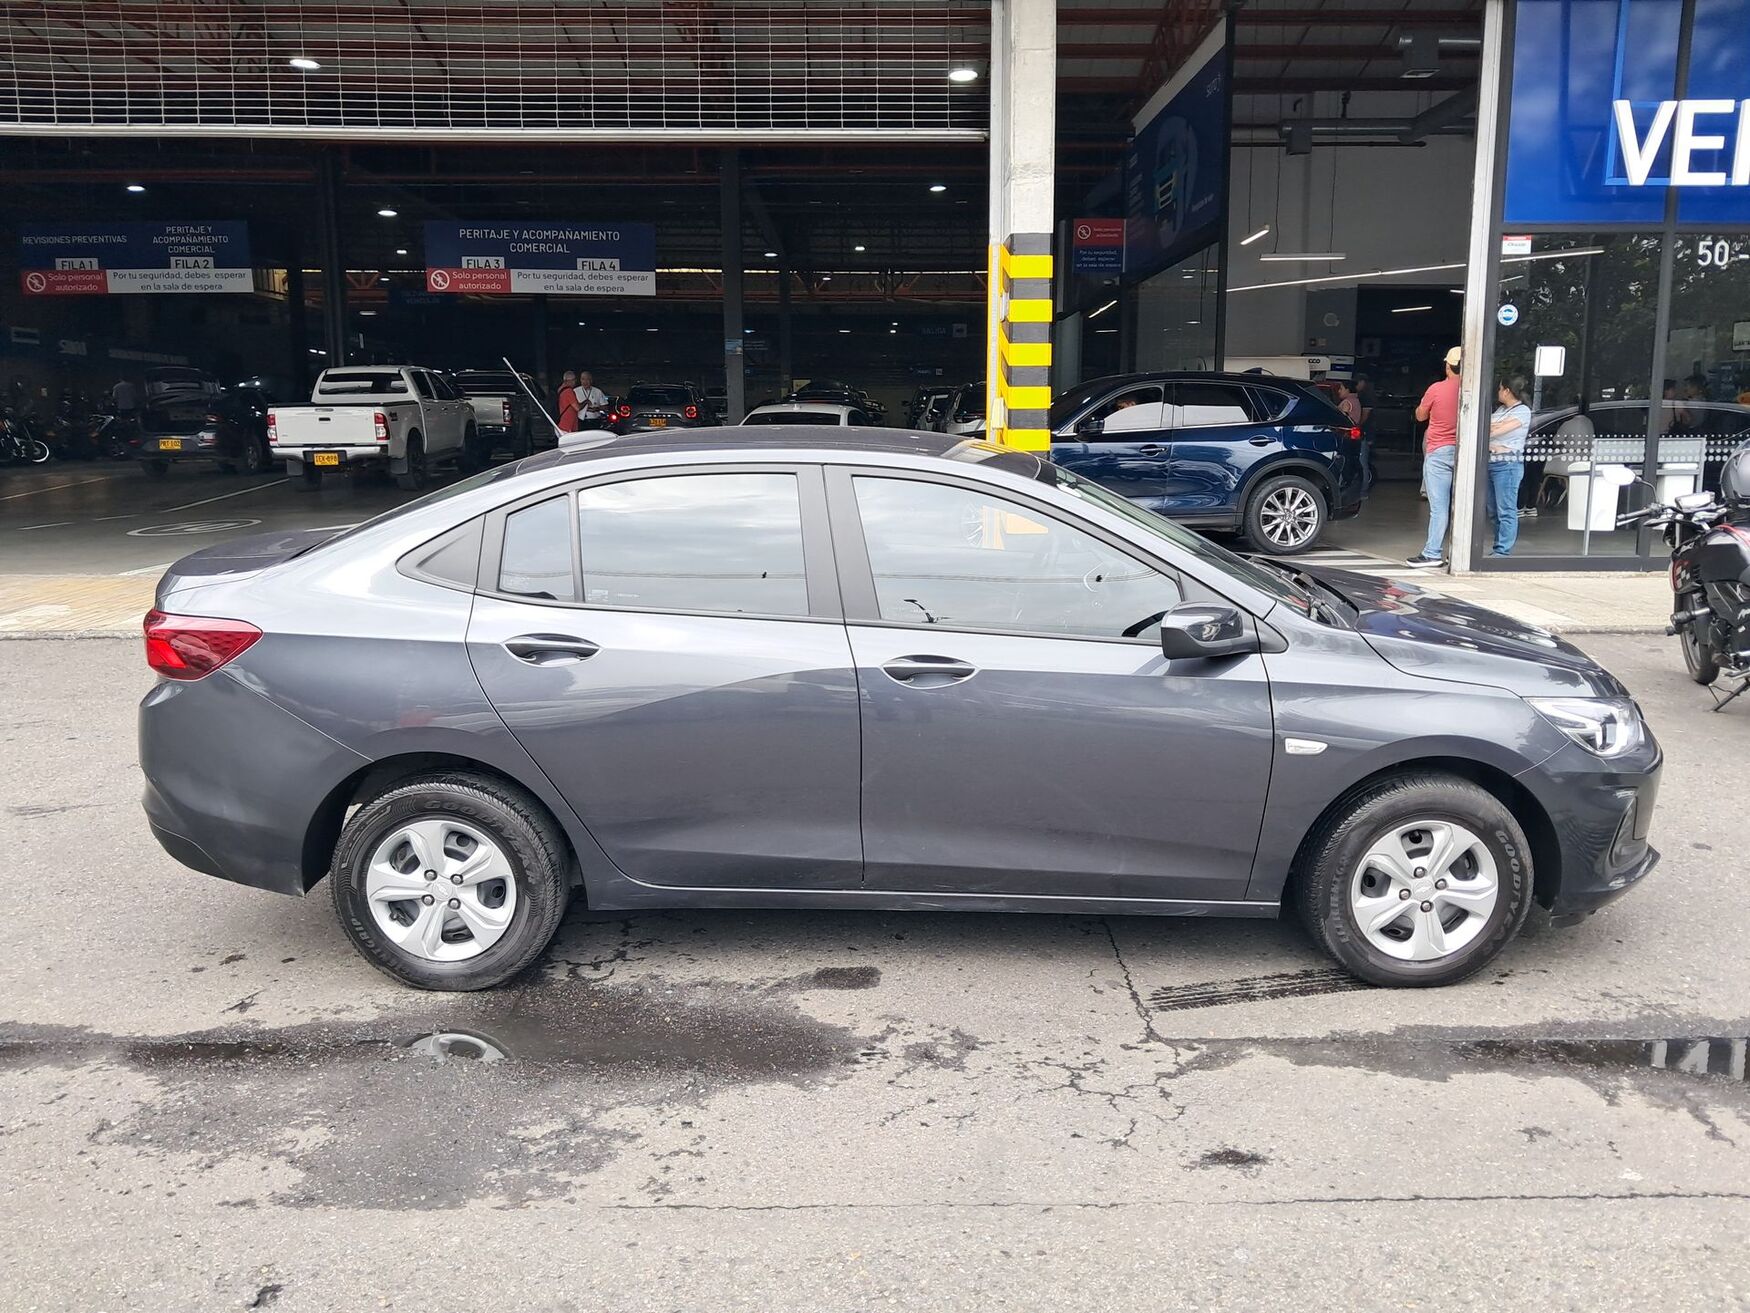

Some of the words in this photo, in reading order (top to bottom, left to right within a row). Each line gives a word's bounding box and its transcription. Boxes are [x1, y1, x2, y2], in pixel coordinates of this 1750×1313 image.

[1613, 99, 1750, 186] VE
[166, 225, 205, 234] PERITAJE
[207, 225, 212, 234] Y
[459, 228, 511, 239] PERITAJE
[512, 229, 519, 239] Y
[522, 228, 620, 241] ACOMPAÑAMIENTO
[22, 235, 71, 245] REVISIONES
[72, 235, 127, 244] PREVENTIVAS
[152, 234, 229, 244] ACOMPAÑAMIENTO
[168, 245, 215, 254] COMERCIAL
[509, 242, 571, 253] COMERCIAL
[61, 260, 86, 270] FILA
[175, 259, 200, 269] FILA
[203, 259, 210, 269] 2
[467, 259, 491, 269] FILA
[494, 259, 500, 269] 3
[581, 260, 607, 271] FILA
[609, 260, 616, 271] 4
[48, 273, 67, 281] Solo
[68, 273, 103, 282] personal
[113, 272, 127, 280] Por
[129, 272, 137, 280] tu
[184, 271, 211, 279] debes
[214, 272, 246, 281] esperar
[452, 271, 471, 279] Solo
[472, 272, 507, 280] personal
[517, 271, 532, 279] Por
[542, 272, 586, 281] seguridad,
[587, 273, 614, 281] debes
[617, 274, 649, 282] esperar
[153, 283, 161, 291] la
[162, 283, 179, 291] sala
[459, 282, 502, 290] autorizado
[556, 283, 564, 291] la
[565, 284, 582, 292] sala
[583, 284, 595, 292] de
[596, 285, 625, 293] espera
